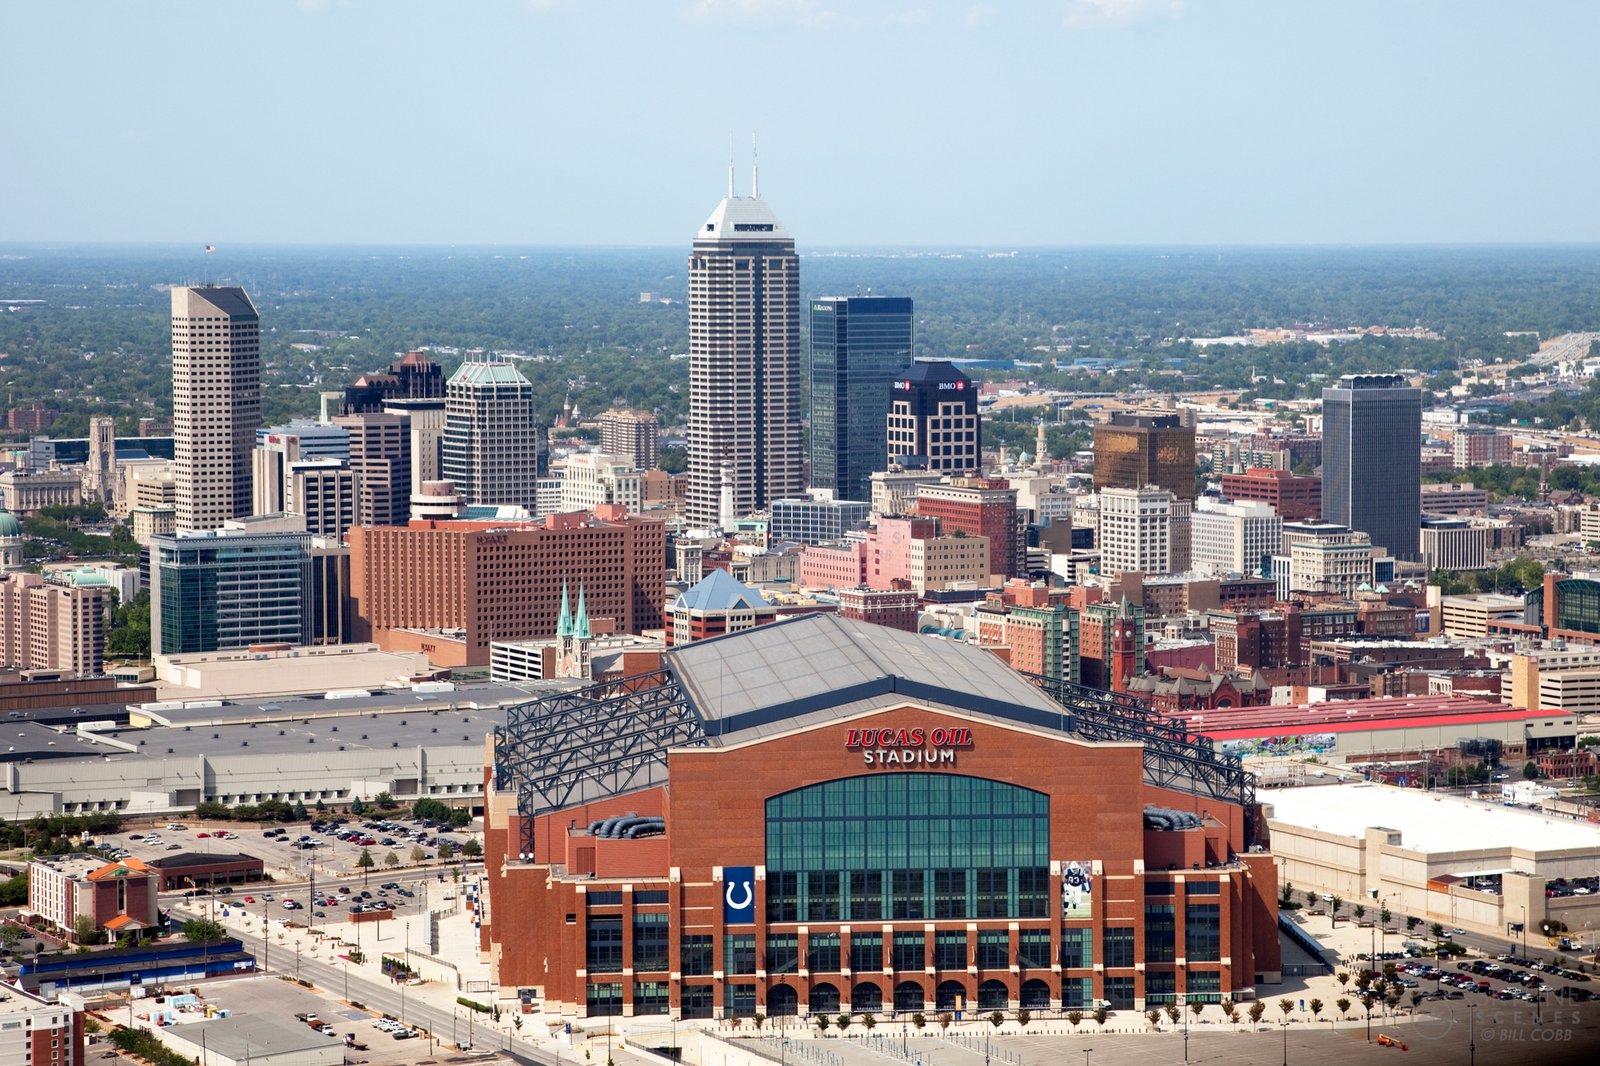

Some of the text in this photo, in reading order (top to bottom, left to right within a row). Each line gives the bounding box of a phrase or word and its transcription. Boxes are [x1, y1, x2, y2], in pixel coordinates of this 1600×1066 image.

[894, 381, 904, 389] BMO
[938, 382, 956, 390] BMO
[477, 535, 508, 543] HYATT
[845, 726, 973, 747] LUCAS OIL
[864, 749, 954, 763] STADIUM
